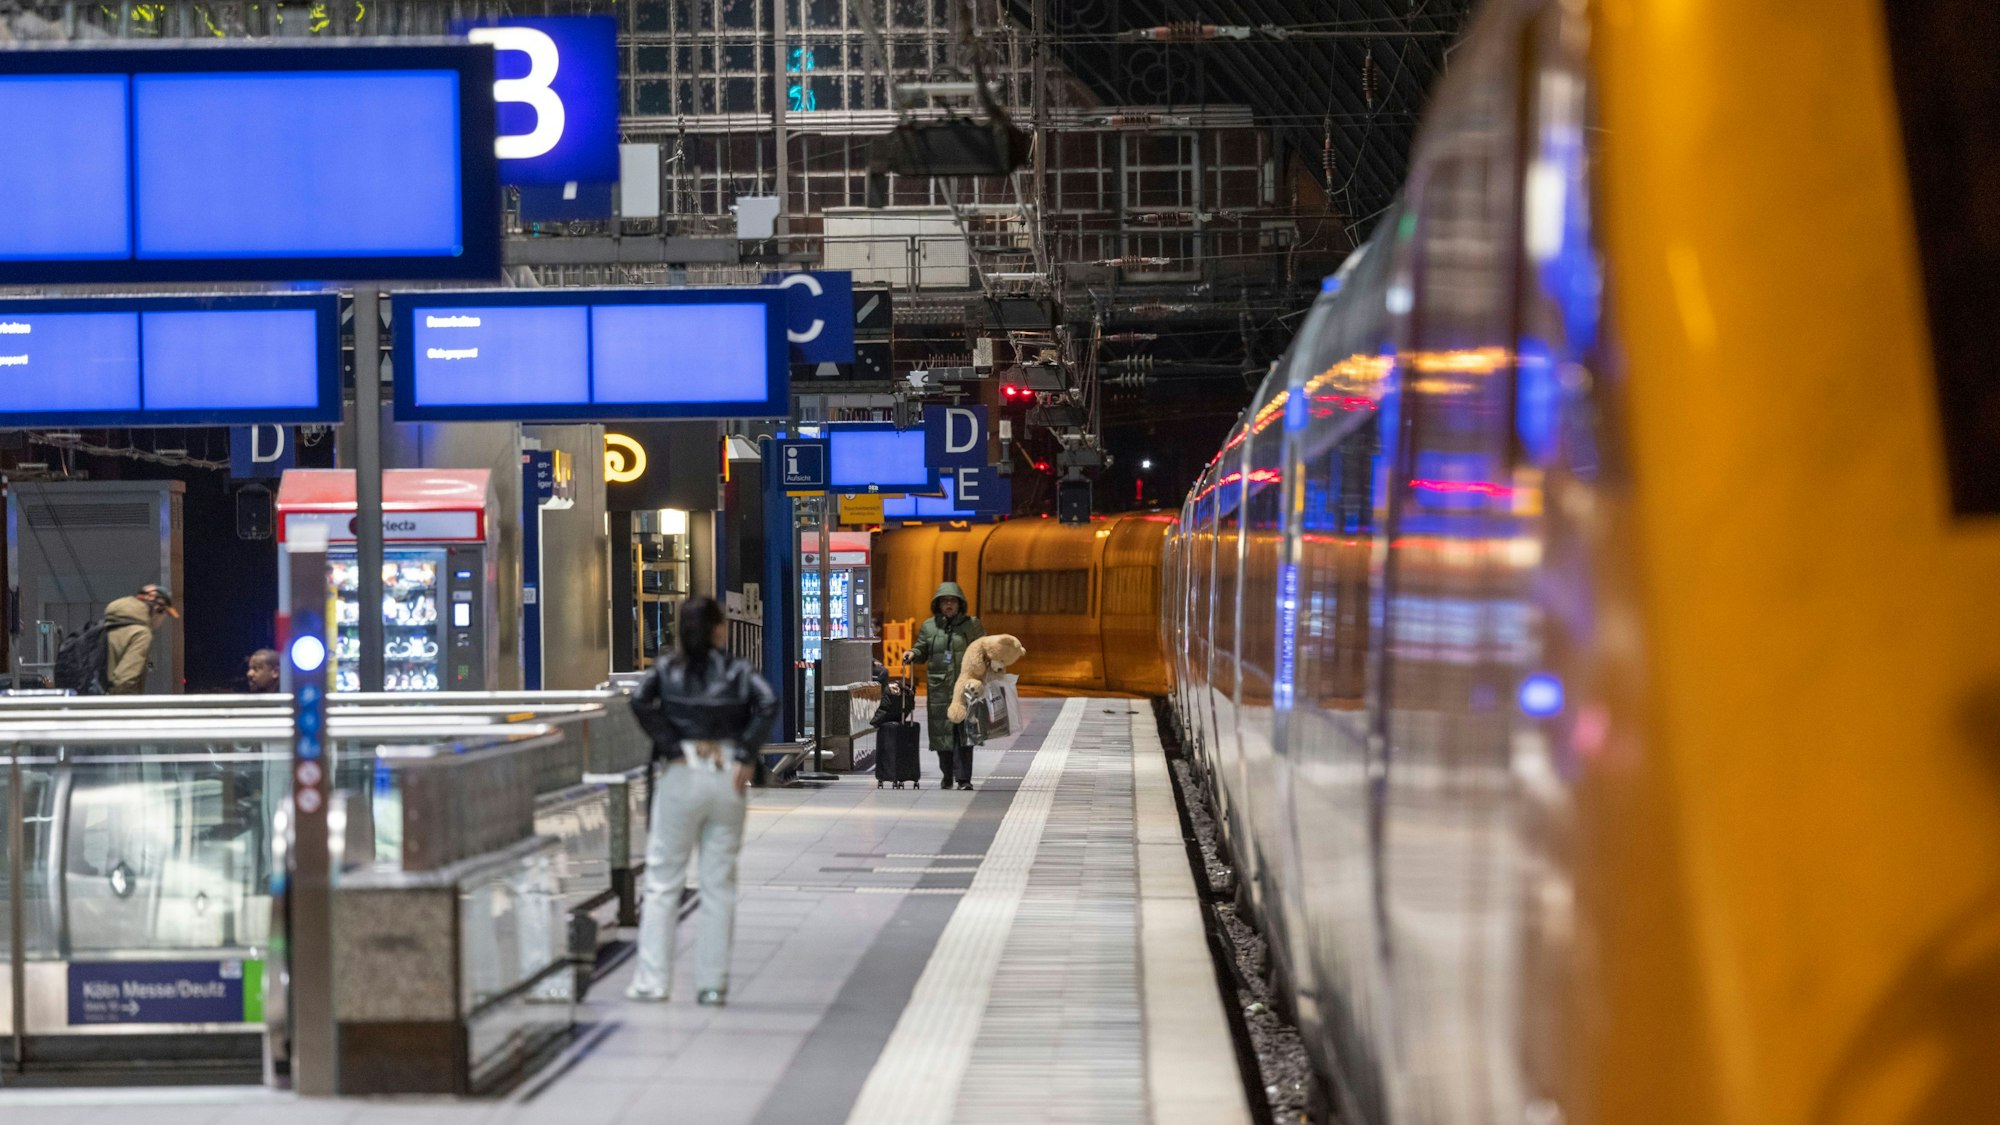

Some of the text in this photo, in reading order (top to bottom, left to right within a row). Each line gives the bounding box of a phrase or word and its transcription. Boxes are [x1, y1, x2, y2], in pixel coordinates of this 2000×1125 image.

[780, 273, 825, 343] C
[251, 424, 285, 462] D
[945, 408, 978, 453] D
[959, 468, 979, 500] E
